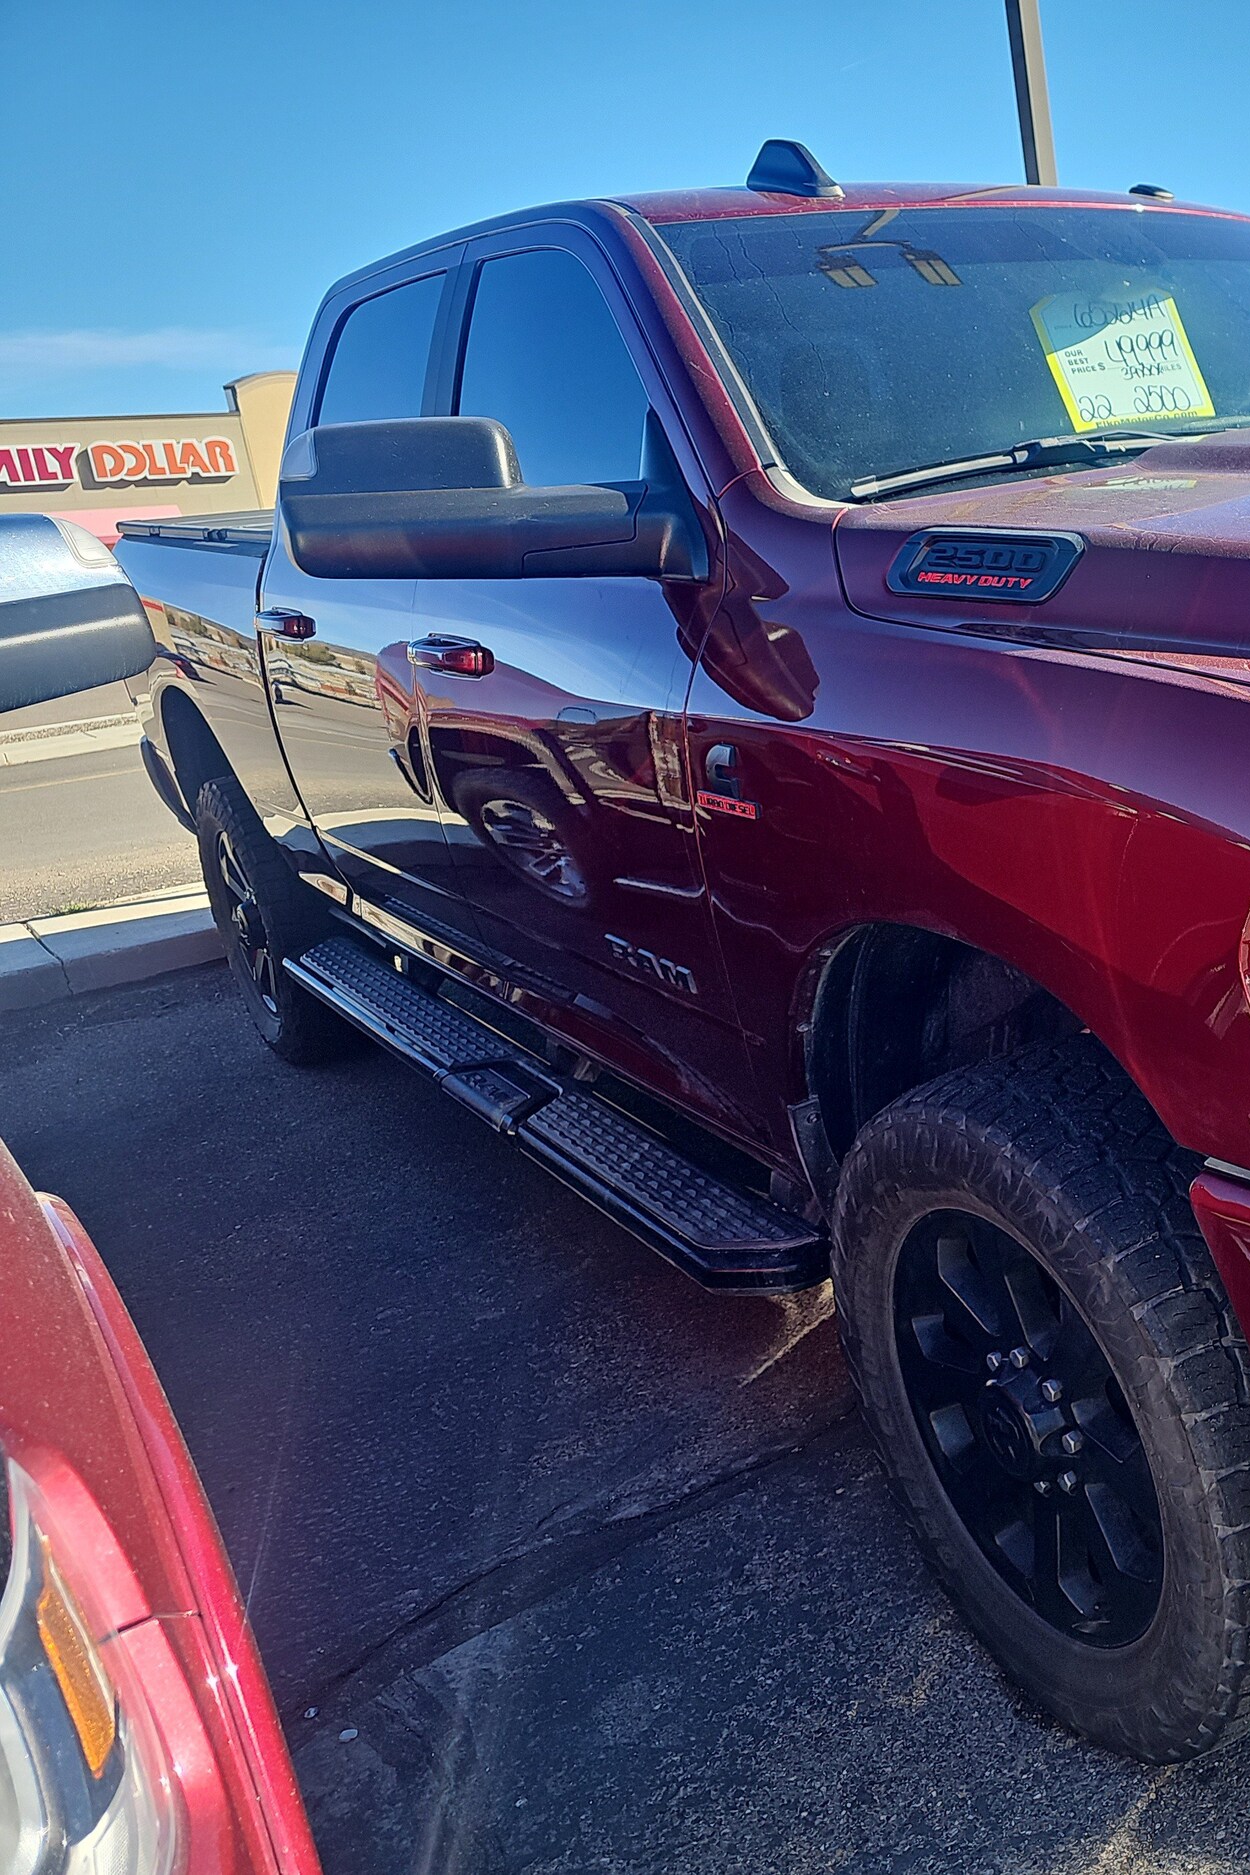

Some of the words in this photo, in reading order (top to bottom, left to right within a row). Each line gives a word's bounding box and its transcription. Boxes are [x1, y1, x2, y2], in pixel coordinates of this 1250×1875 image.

[1065, 350, 1083, 358] OUR
[1068, 357, 1089, 366] BEST
[1104, 329, 1179, 368] 49999
[1071, 366, 1097, 375] PRICE
[1079, 394, 1116, 422] 22
[1134, 386, 1190, 414] 2500
[90, 440, 237, 479] DOLLAR
[927, 546, 1046, 572] 2500
[918, 571, 978, 586] HEAVY
[978, 576, 1033, 589] DUTY
[603, 933, 698, 994] RAM
